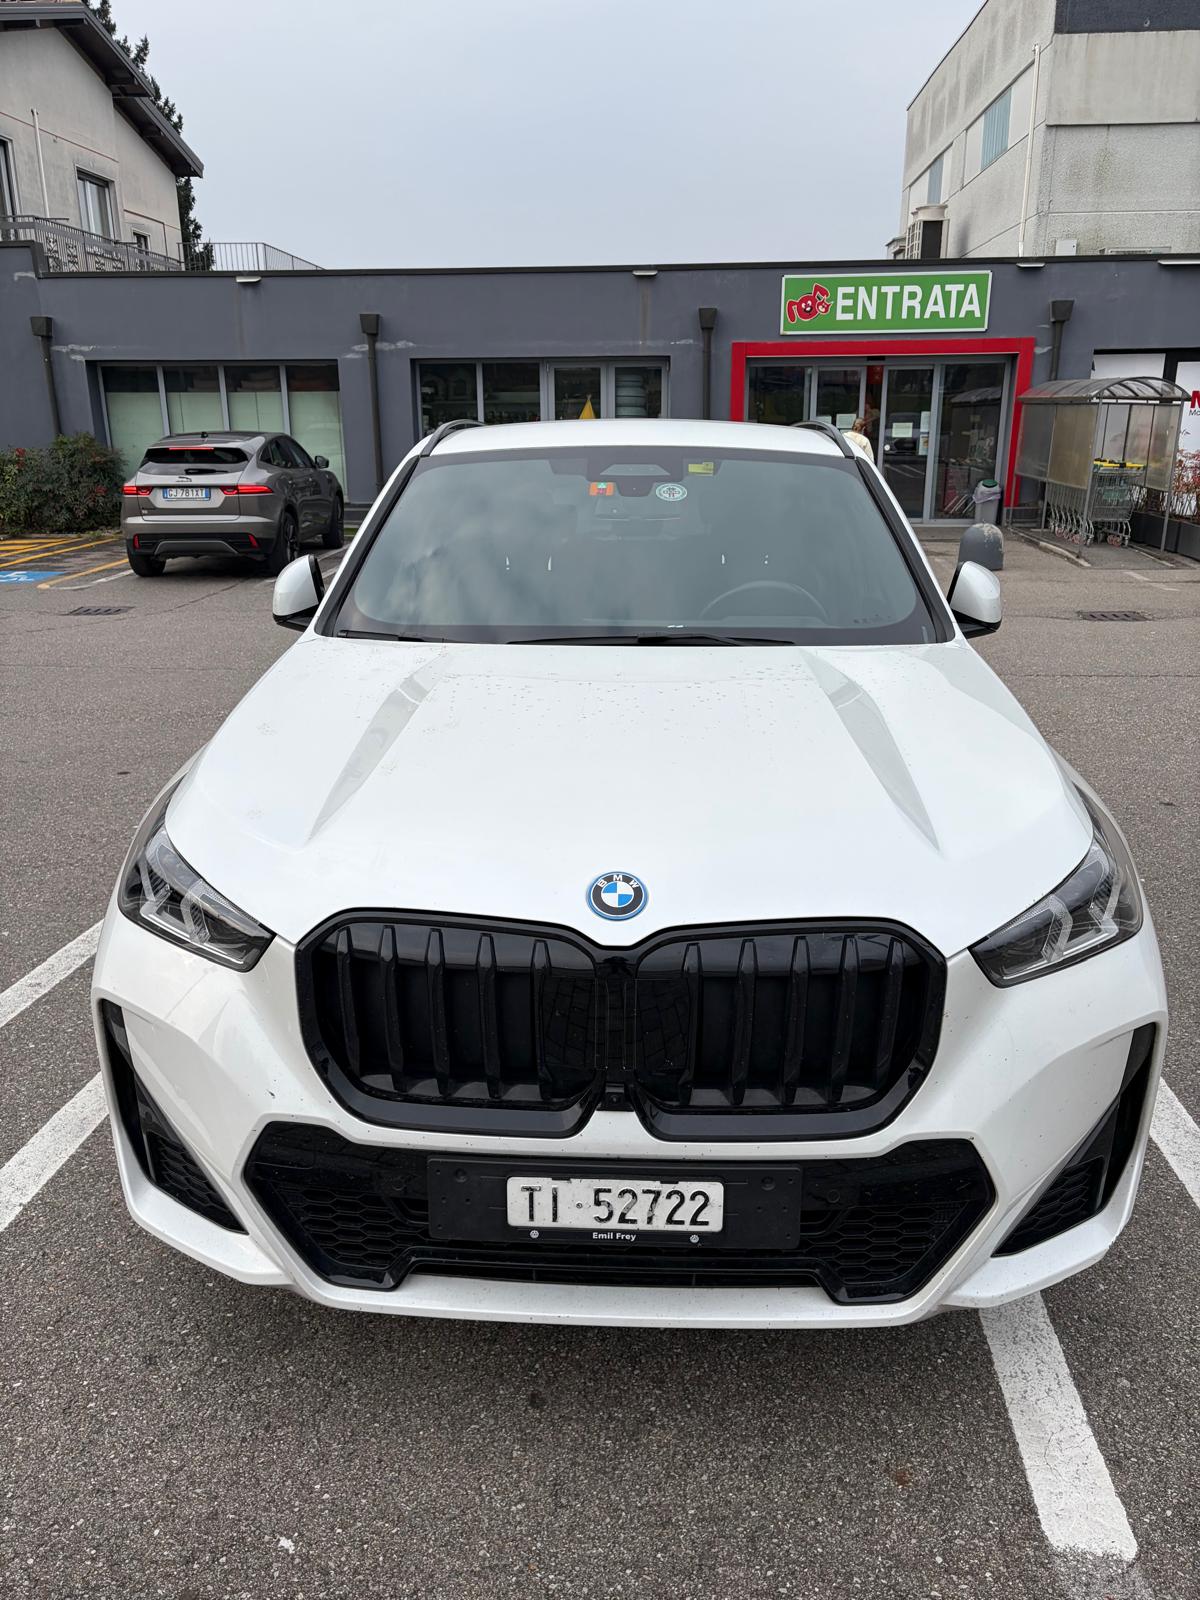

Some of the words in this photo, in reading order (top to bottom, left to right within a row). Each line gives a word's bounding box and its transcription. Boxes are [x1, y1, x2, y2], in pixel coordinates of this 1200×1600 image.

[835, 283, 981, 321] ENTRATA
[596, 874, 640, 889] BMW
[520, 1185, 558, 1223] TI
[593, 1187, 711, 1227] 52722
[592, 1231, 615, 1241] Emil
[616, 1232, 637, 1242] Frey
